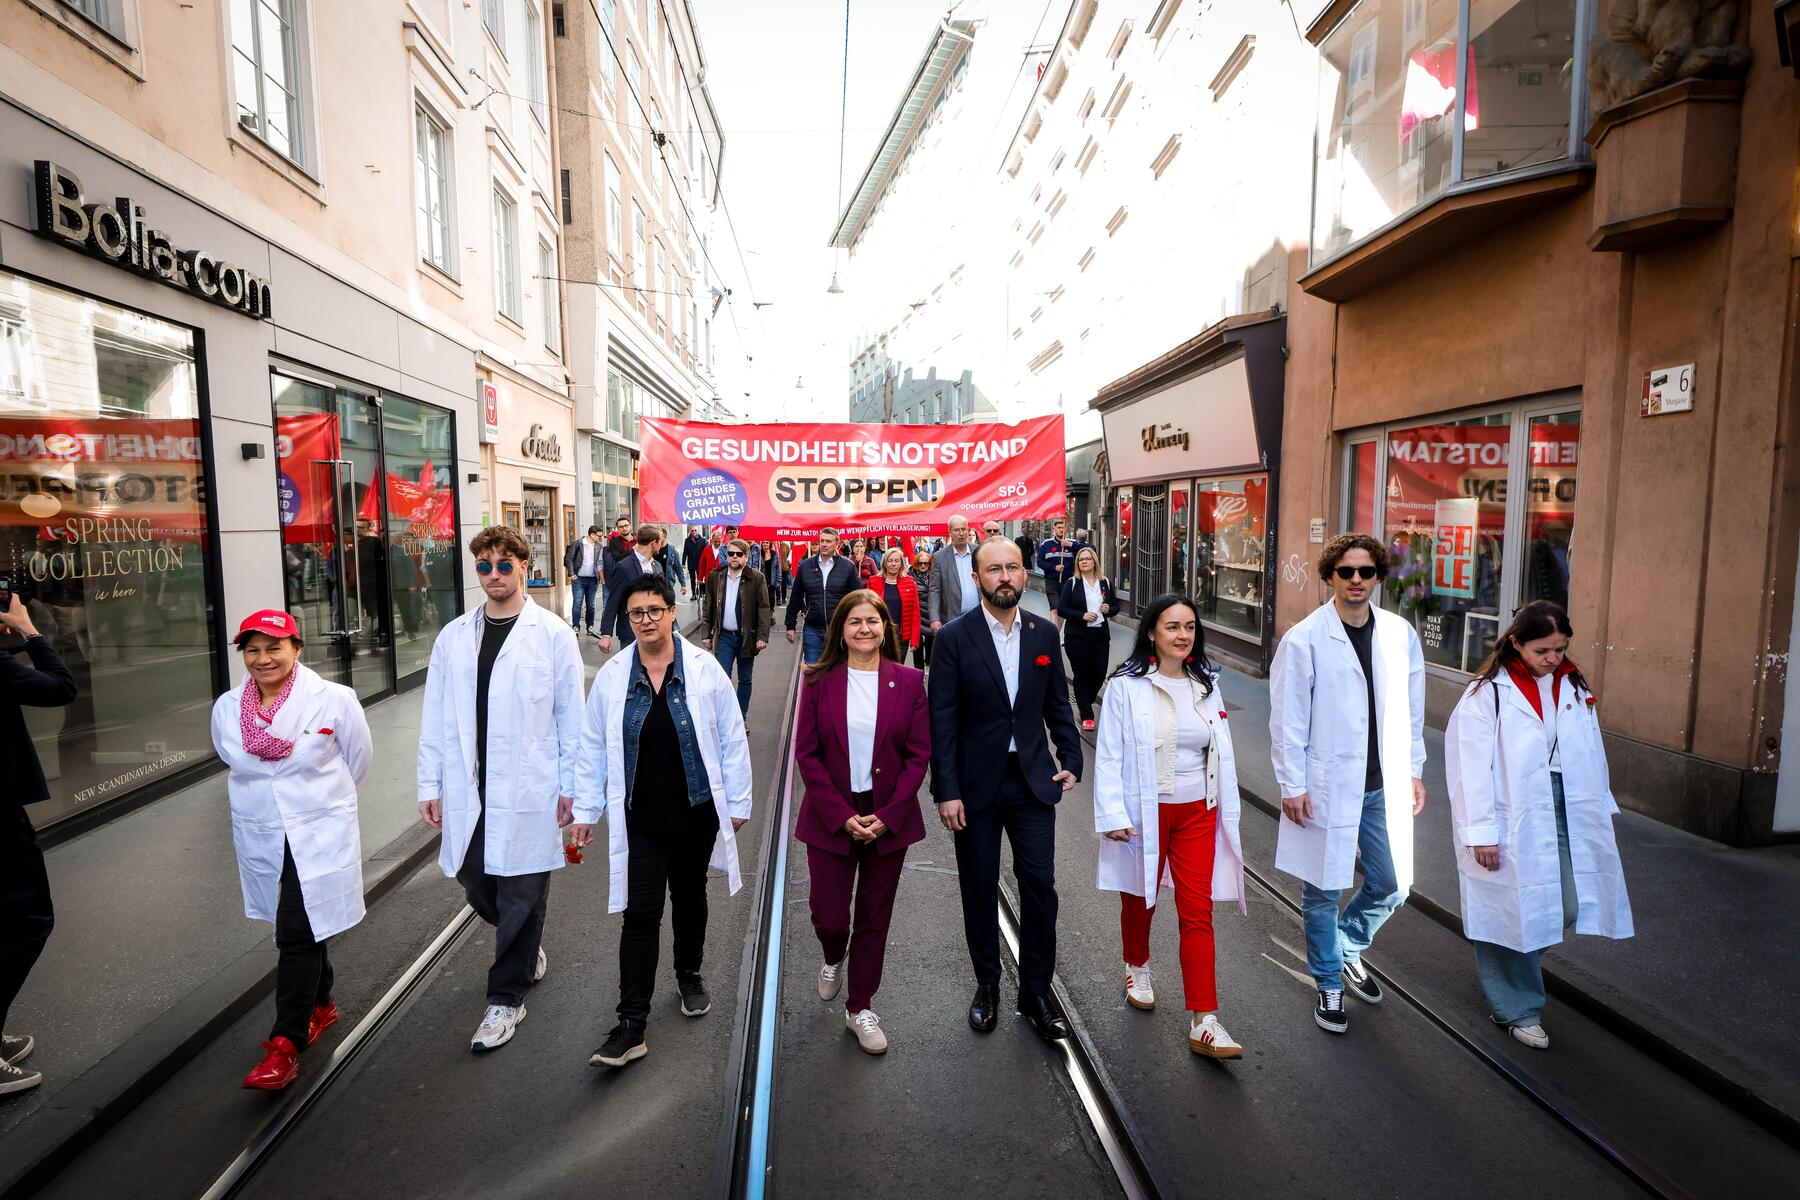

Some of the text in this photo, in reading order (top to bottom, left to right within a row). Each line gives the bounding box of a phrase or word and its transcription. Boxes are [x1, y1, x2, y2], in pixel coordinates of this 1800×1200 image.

[1680, 368, 1689, 392] 6
[681, 437, 1028, 465] GESUNDHEITSNOTSTAND
[691, 475, 725, 486] BESSER:
[683, 483, 736, 498] G'SUNDES
[775, 476, 938, 504] STOPPEN!
[998, 482, 1028, 498] SPÖ
[686, 493, 736, 509] GRAZ MIT
[960, 497, 1029, 511] operation-graz.at
[682, 502, 745, 522] KAMPUS!
[66, 517, 151, 545] SPRING
[412, 523, 438, 538] SPRING
[791, 529, 801, 537] ZUR
[802, 529, 818, 537] NATO!
[403, 539, 448, 556] COLLECTION
[29, 547, 183, 582] COLLECTION
[95, 581, 137, 600] is here
[74, 750, 186, 804] NEW SCANDINAVIAN DESIGN
